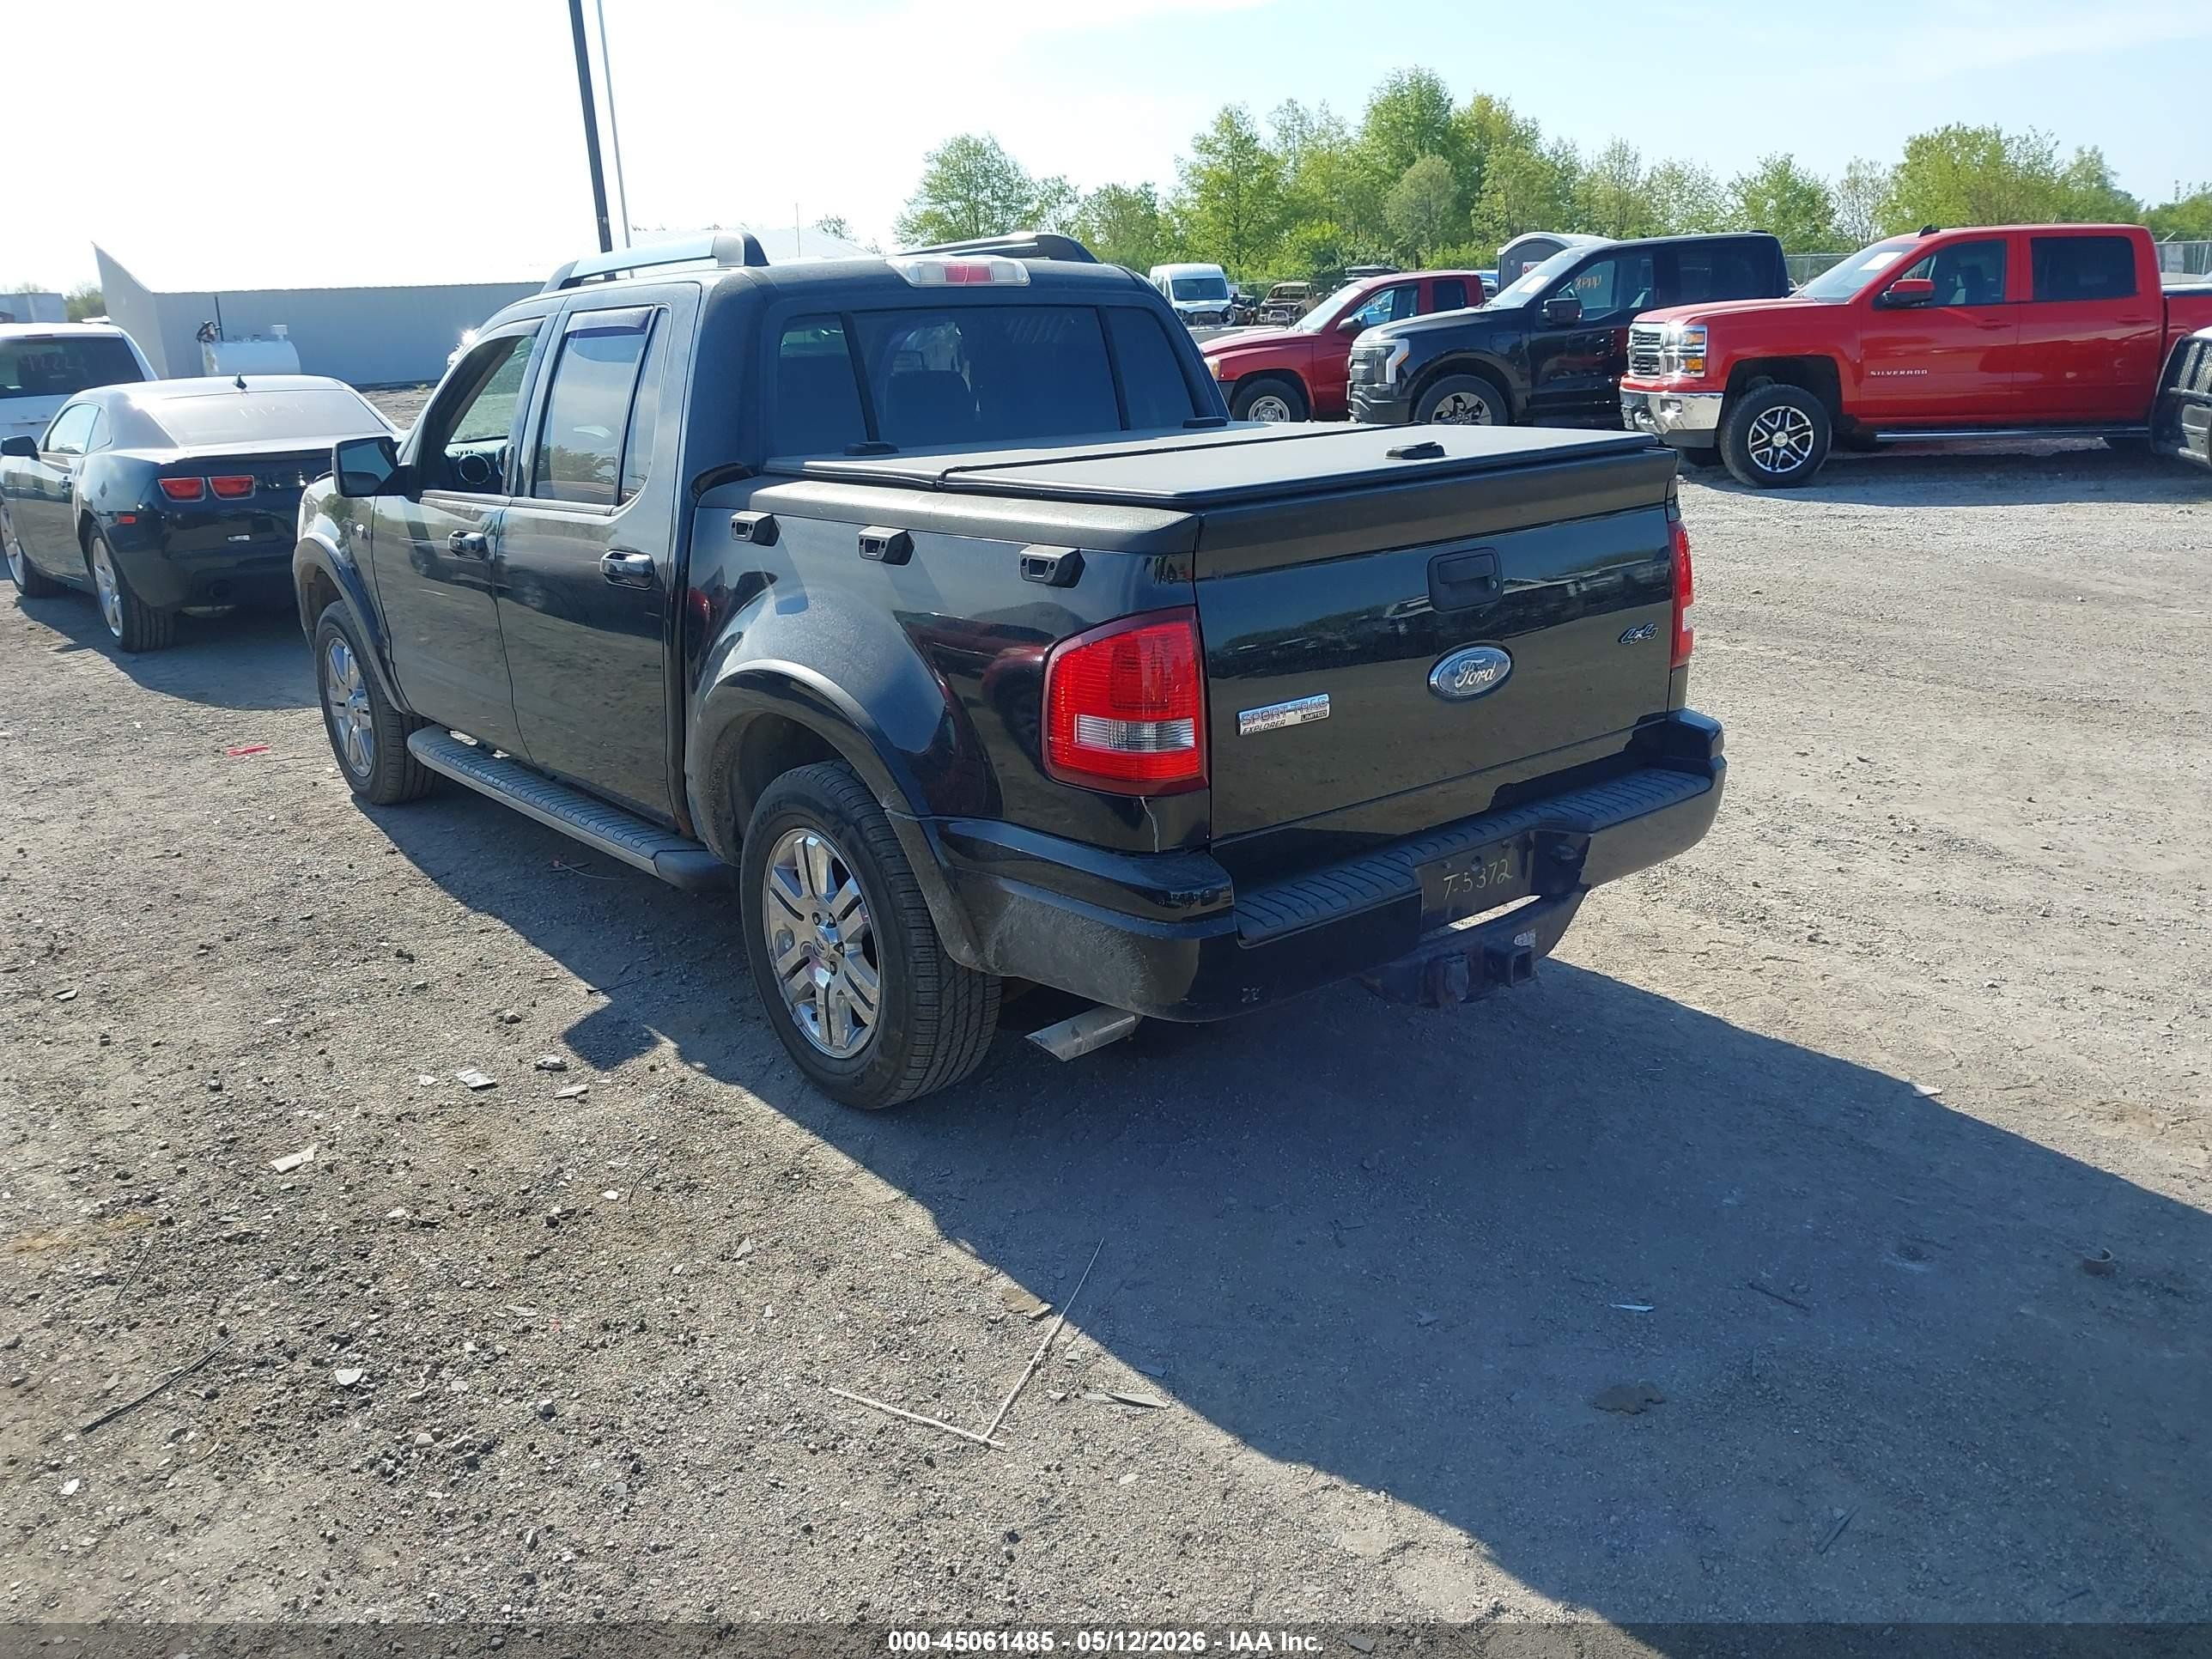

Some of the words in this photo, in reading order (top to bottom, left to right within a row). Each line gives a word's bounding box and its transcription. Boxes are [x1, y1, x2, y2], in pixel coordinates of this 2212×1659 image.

[1455, 658, 1497, 688] Ford
[1241, 703, 1287, 726] SPORT
[1290, 696, 1328, 715] TRAC
[1301, 709, 1328, 721] LIMITED
[1243, 719, 1286, 734] EXPLORER
